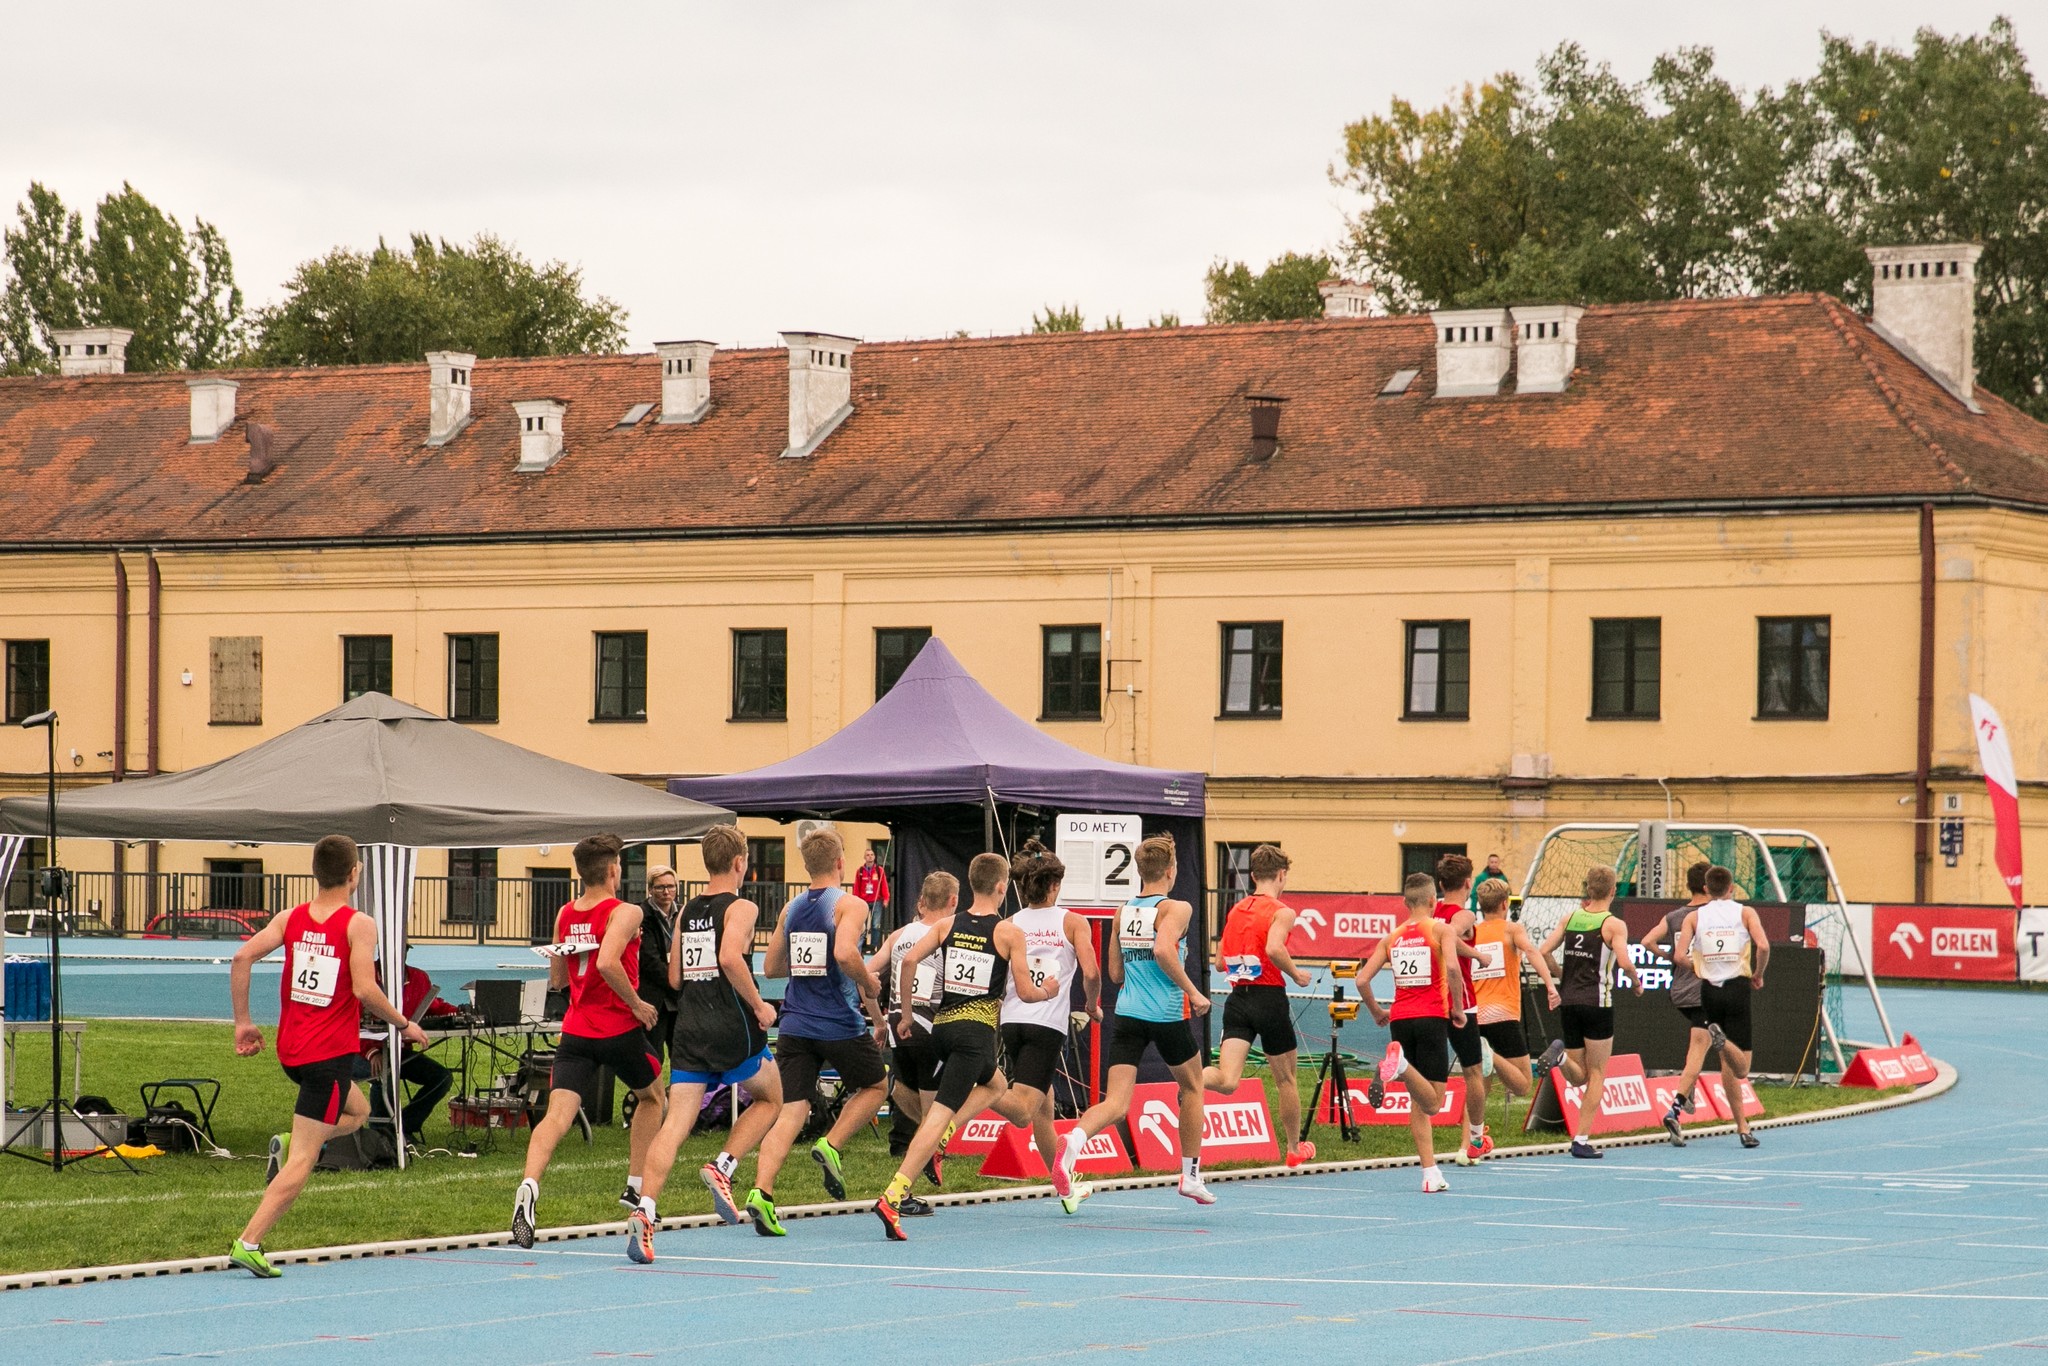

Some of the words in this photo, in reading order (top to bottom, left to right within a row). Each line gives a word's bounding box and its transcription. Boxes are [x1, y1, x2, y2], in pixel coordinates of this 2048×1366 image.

[1070, 821, 1088, 832] DO
[1092, 822, 1127, 833] METY
[1105, 843, 1131, 885] 2
[1653, 856, 1661, 897] SCHAPE
[1126, 919, 1143, 937] 42
[1338, 917, 1391, 934] ORLEN
[953, 932, 988, 943] ZANTYR
[1574, 934, 1584, 949] 2
[1716, 939, 1724, 953] 9
[1936, 932, 1992, 951] ORLEN
[685, 948, 703, 967] 37
[796, 947, 813, 964] 36
[959, 952, 990, 965] Kraków
[954, 963, 976, 984] 34
[1400, 959, 1418, 976] 26
[298, 969, 320, 990] 45
[1601, 1081, 1647, 1109] ORLEN
[967, 1122, 1003, 1138] ORLE
[1201, 1109, 1263, 1140] ORLEN
[1079, 1138, 1113, 1155] RLEN
